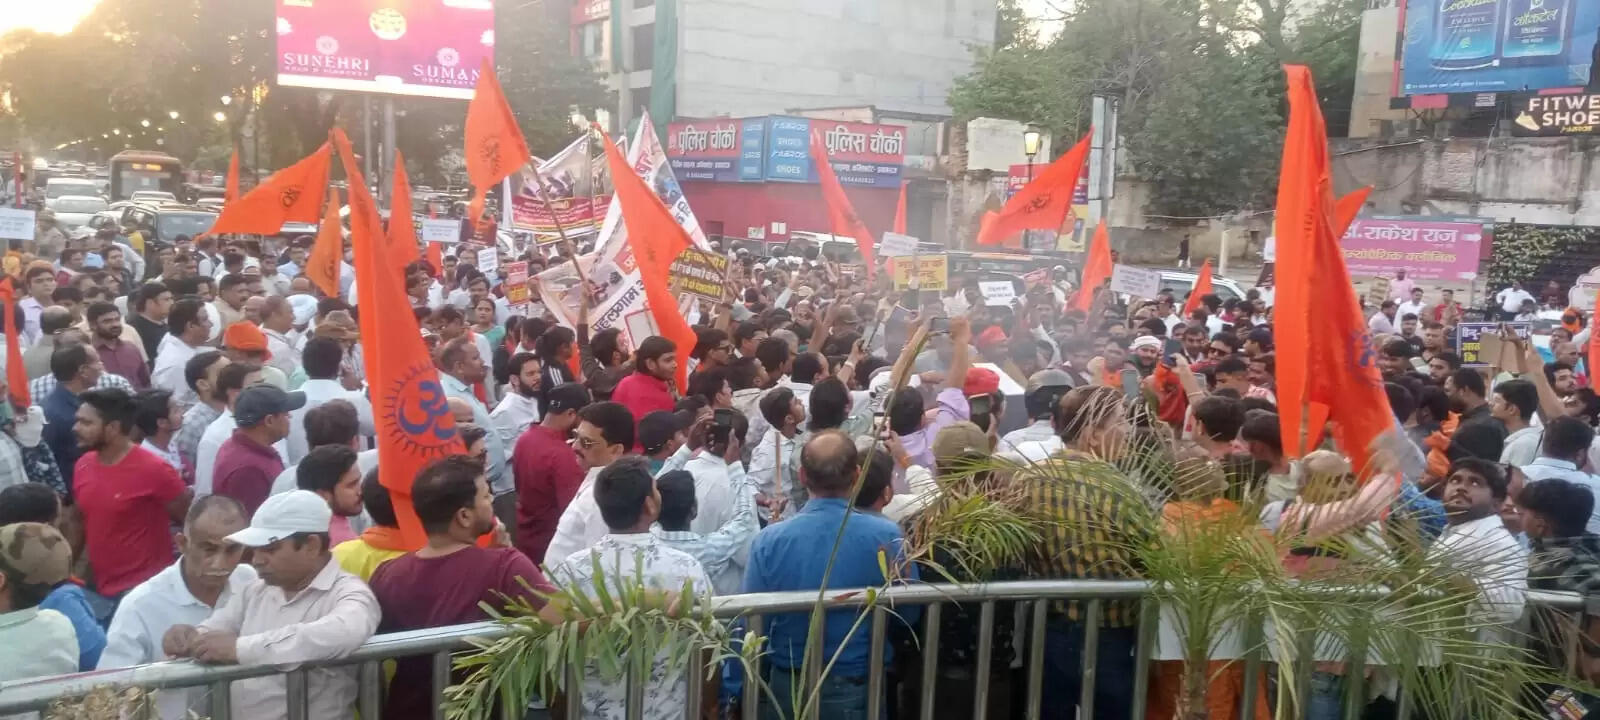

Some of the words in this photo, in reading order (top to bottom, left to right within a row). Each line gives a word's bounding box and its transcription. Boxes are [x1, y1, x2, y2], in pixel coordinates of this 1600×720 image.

[283, 52, 369, 71] SUNEHRI
[412, 63, 481, 81] SUMAN
[1528, 95, 1600, 111] FITWE
[1542, 111, 1600, 126] SHOE
[679, 124, 708, 154] पुलिस
[825, 125, 865, 155] पुलिस
[870, 128, 903, 155] चौकी
[776, 165, 801, 174] SHOES
[1364, 223, 1419, 241] राकेश
[1422, 228, 1459, 242] राज
